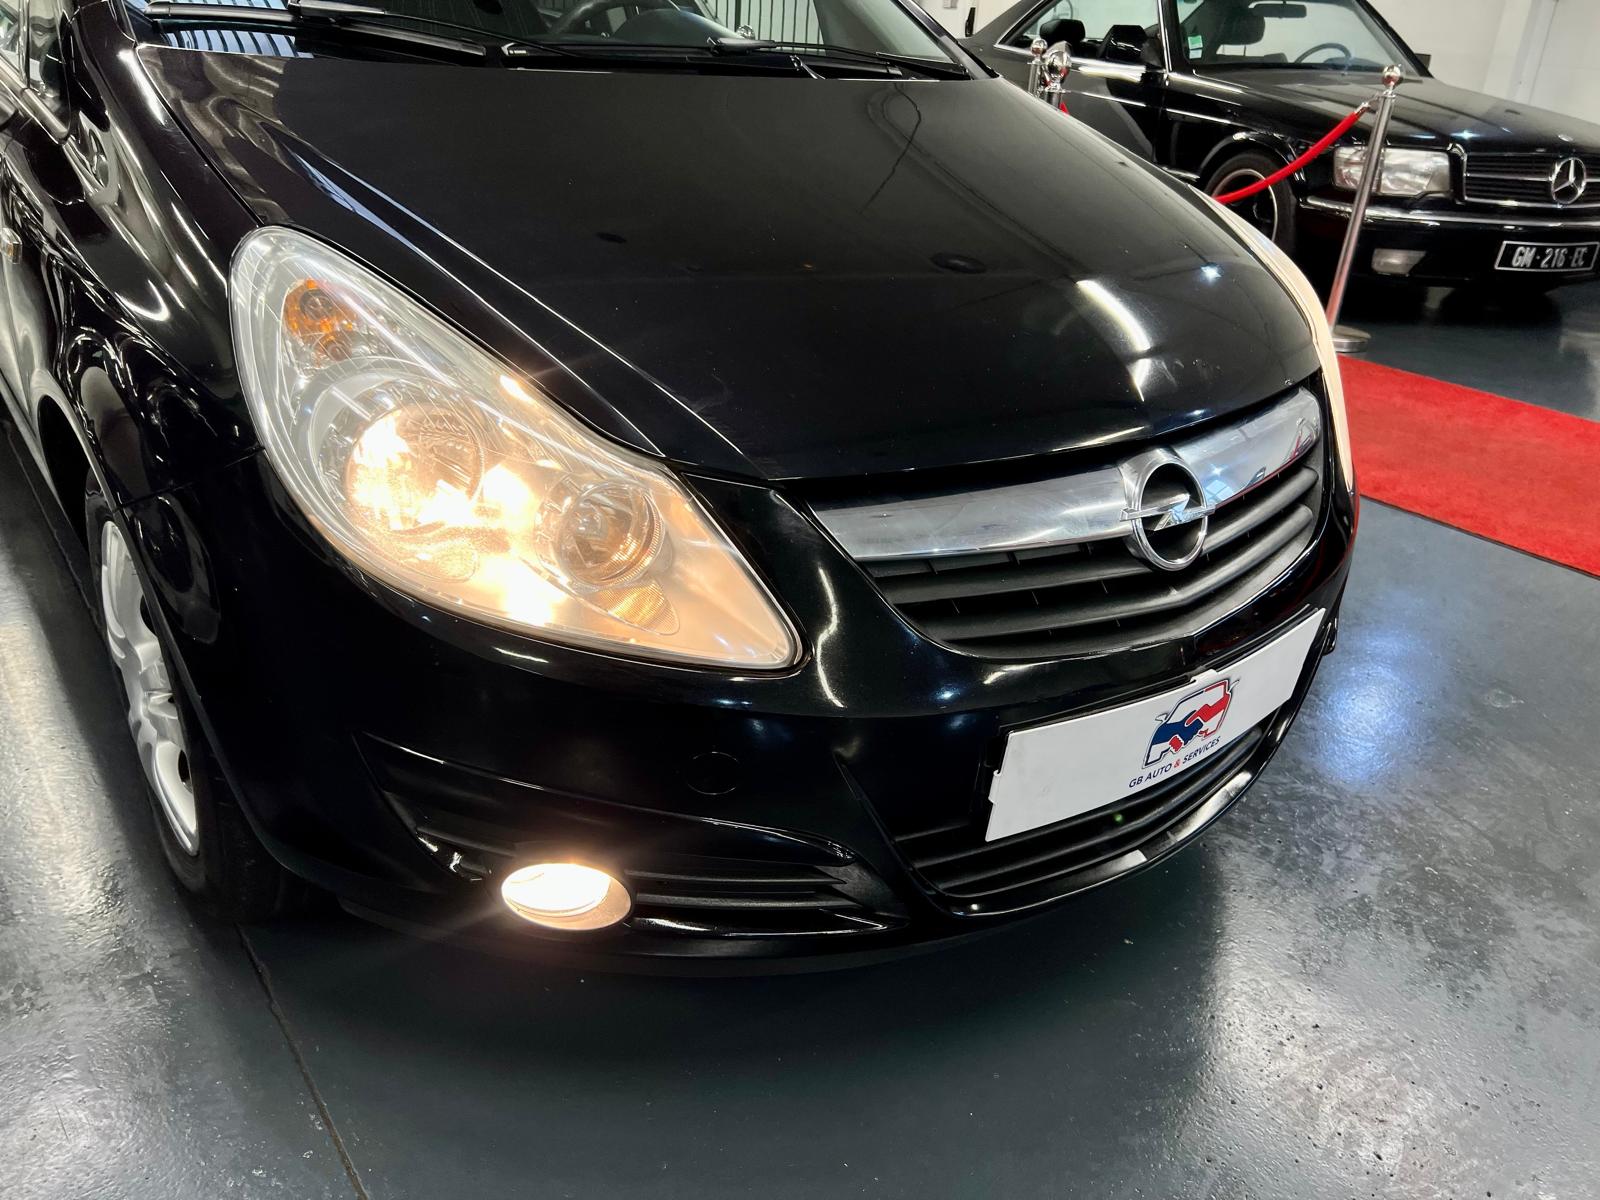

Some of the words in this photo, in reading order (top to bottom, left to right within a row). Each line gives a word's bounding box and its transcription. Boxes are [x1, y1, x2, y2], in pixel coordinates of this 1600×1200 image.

[1129, 776, 1144, 788] GB
[1145, 763, 1172, 781] AUTO
[1173, 758, 1181, 768] &
[1183, 736, 1220, 764] SERVICES
